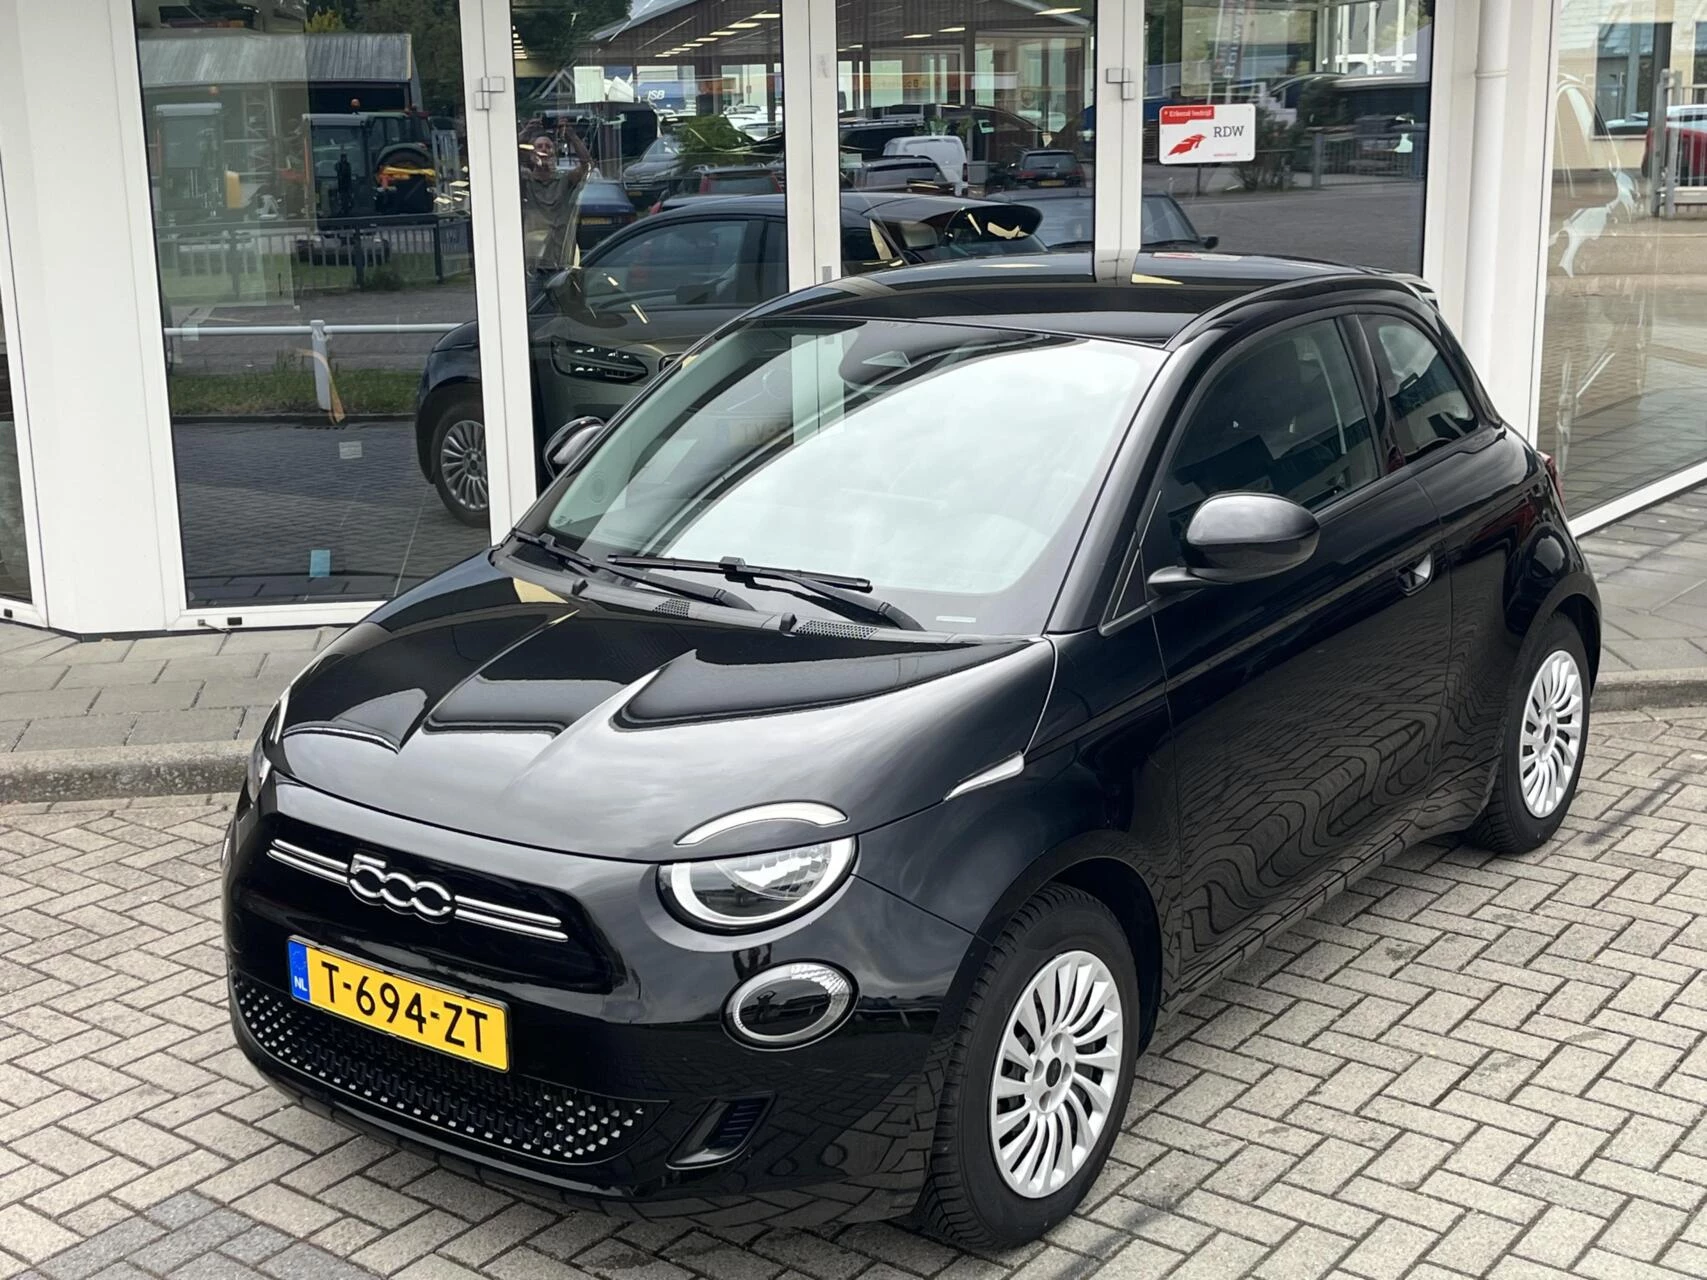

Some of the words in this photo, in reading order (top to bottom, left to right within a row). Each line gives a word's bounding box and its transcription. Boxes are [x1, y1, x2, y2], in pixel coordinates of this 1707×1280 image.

[1213, 125, 1244, 138] RDW
[350, 853, 452, 917] 500
[294, 975, 308, 992] NL
[321, 960, 488, 1053] T-694-ZT
